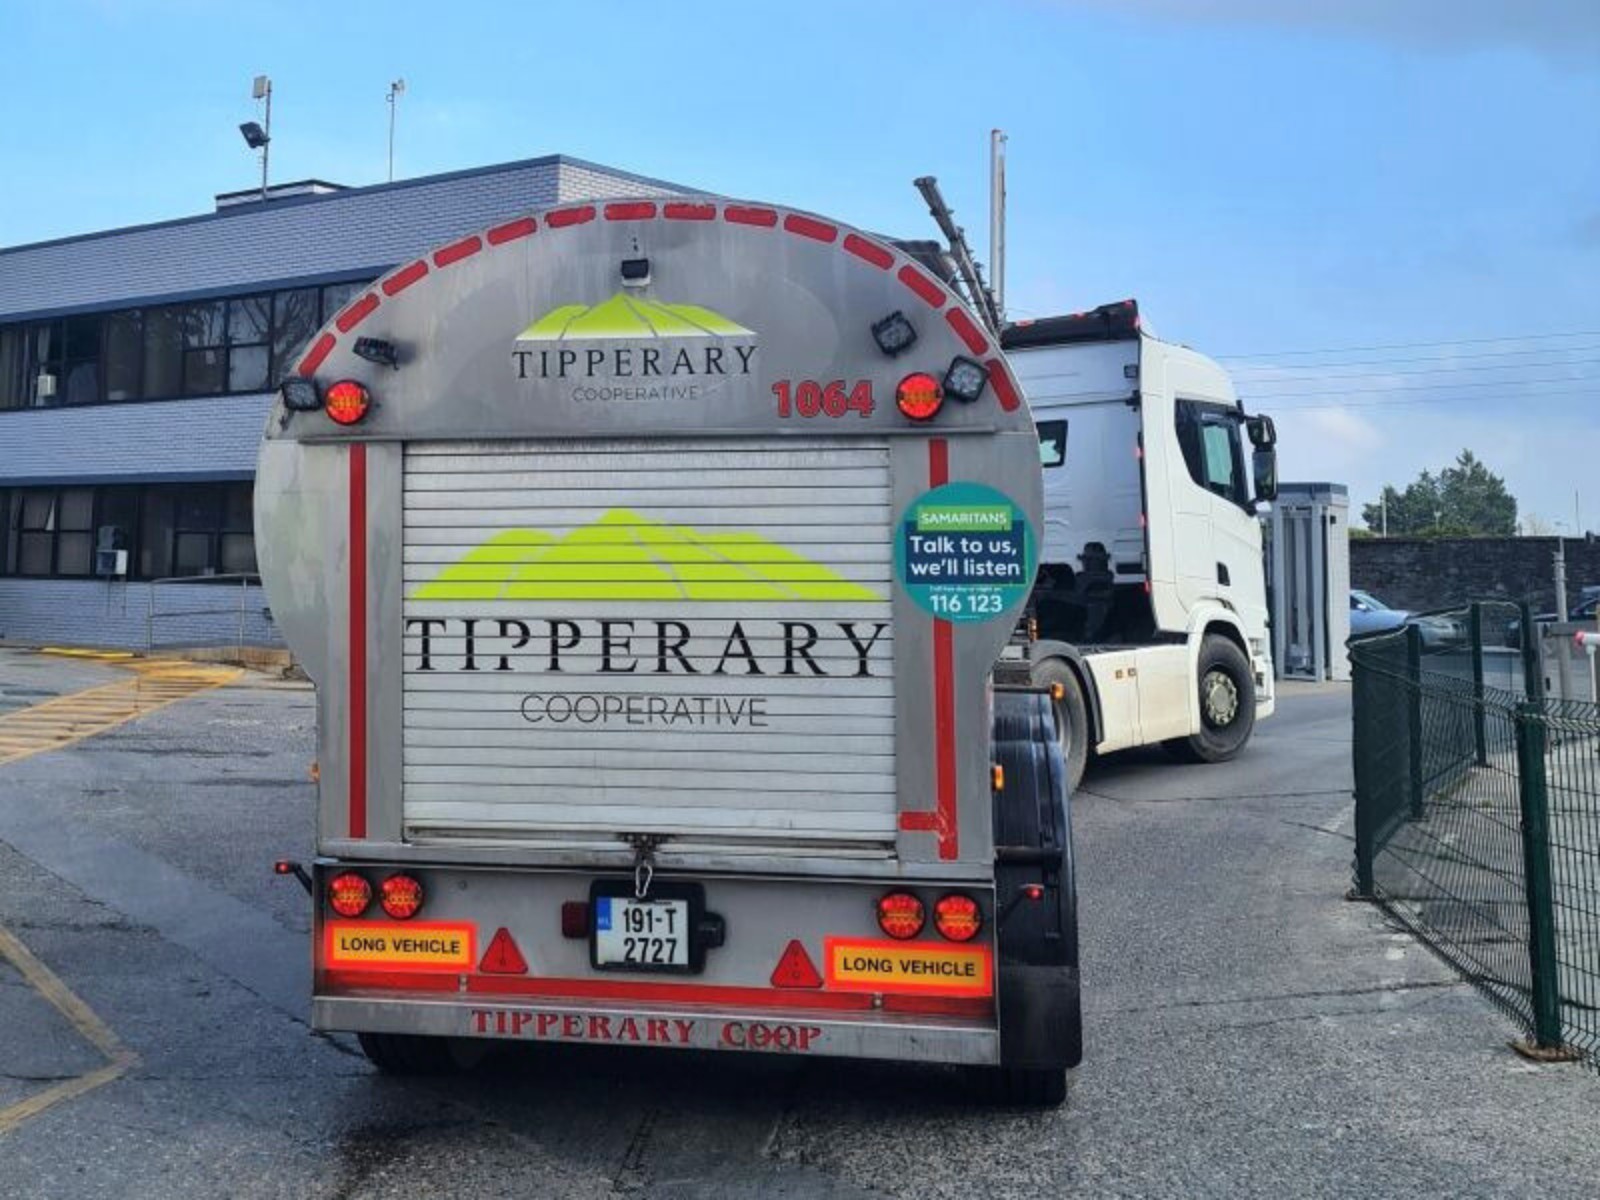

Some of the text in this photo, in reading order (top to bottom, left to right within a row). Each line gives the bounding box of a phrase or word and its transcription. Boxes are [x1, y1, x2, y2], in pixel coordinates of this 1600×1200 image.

[512, 345, 759, 379] TIPPERARY
[571, 385, 699, 401] COOPERATIVE
[771, 379, 876, 418] 1064
[920, 511, 1008, 526] SAMARITANS
[909, 535, 1018, 556] Talk to us,
[910, 558, 1021, 576] we'll listen
[929, 594, 1004, 614] 116 123
[405, 618, 890, 678] TIPPERARY
[520, 693, 769, 728] COOPERATIVE
[622, 907, 678, 935] 191-T
[340, 936, 461, 955] LONG VEHICLE
[623, 937, 678, 964] 2727
[842, 956, 976, 978] LONG VEHICLE
[473, 1010, 822, 1051] TIPPERARY COOP
